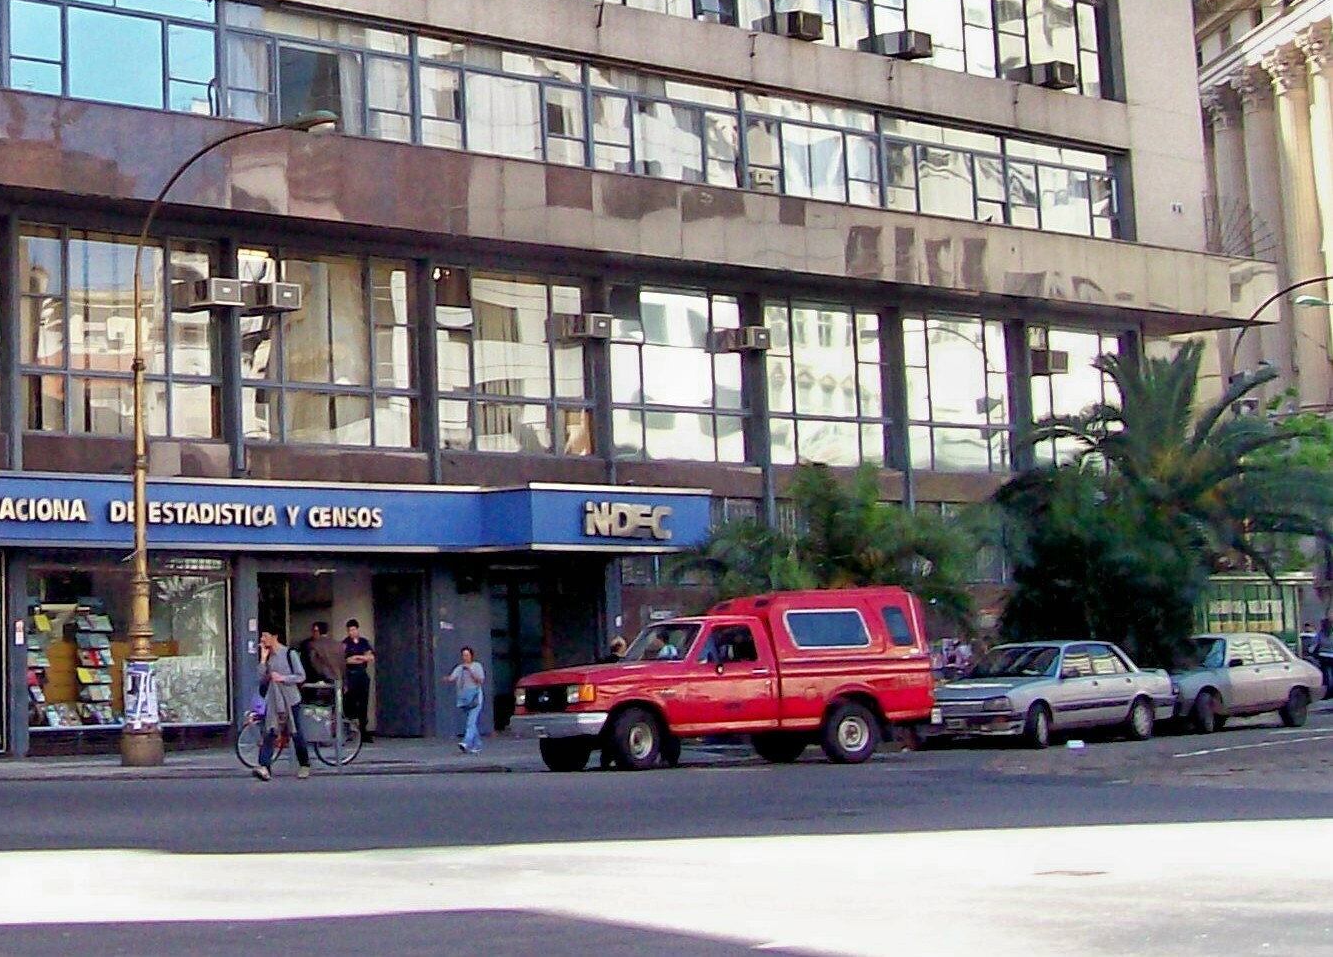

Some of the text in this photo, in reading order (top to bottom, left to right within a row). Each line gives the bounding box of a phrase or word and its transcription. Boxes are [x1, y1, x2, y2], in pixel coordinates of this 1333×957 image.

[148, 501, 277, 527] ESTADISTICA
[287, 505, 300, 527] Y
[308, 506, 383, 529] CENSOS
